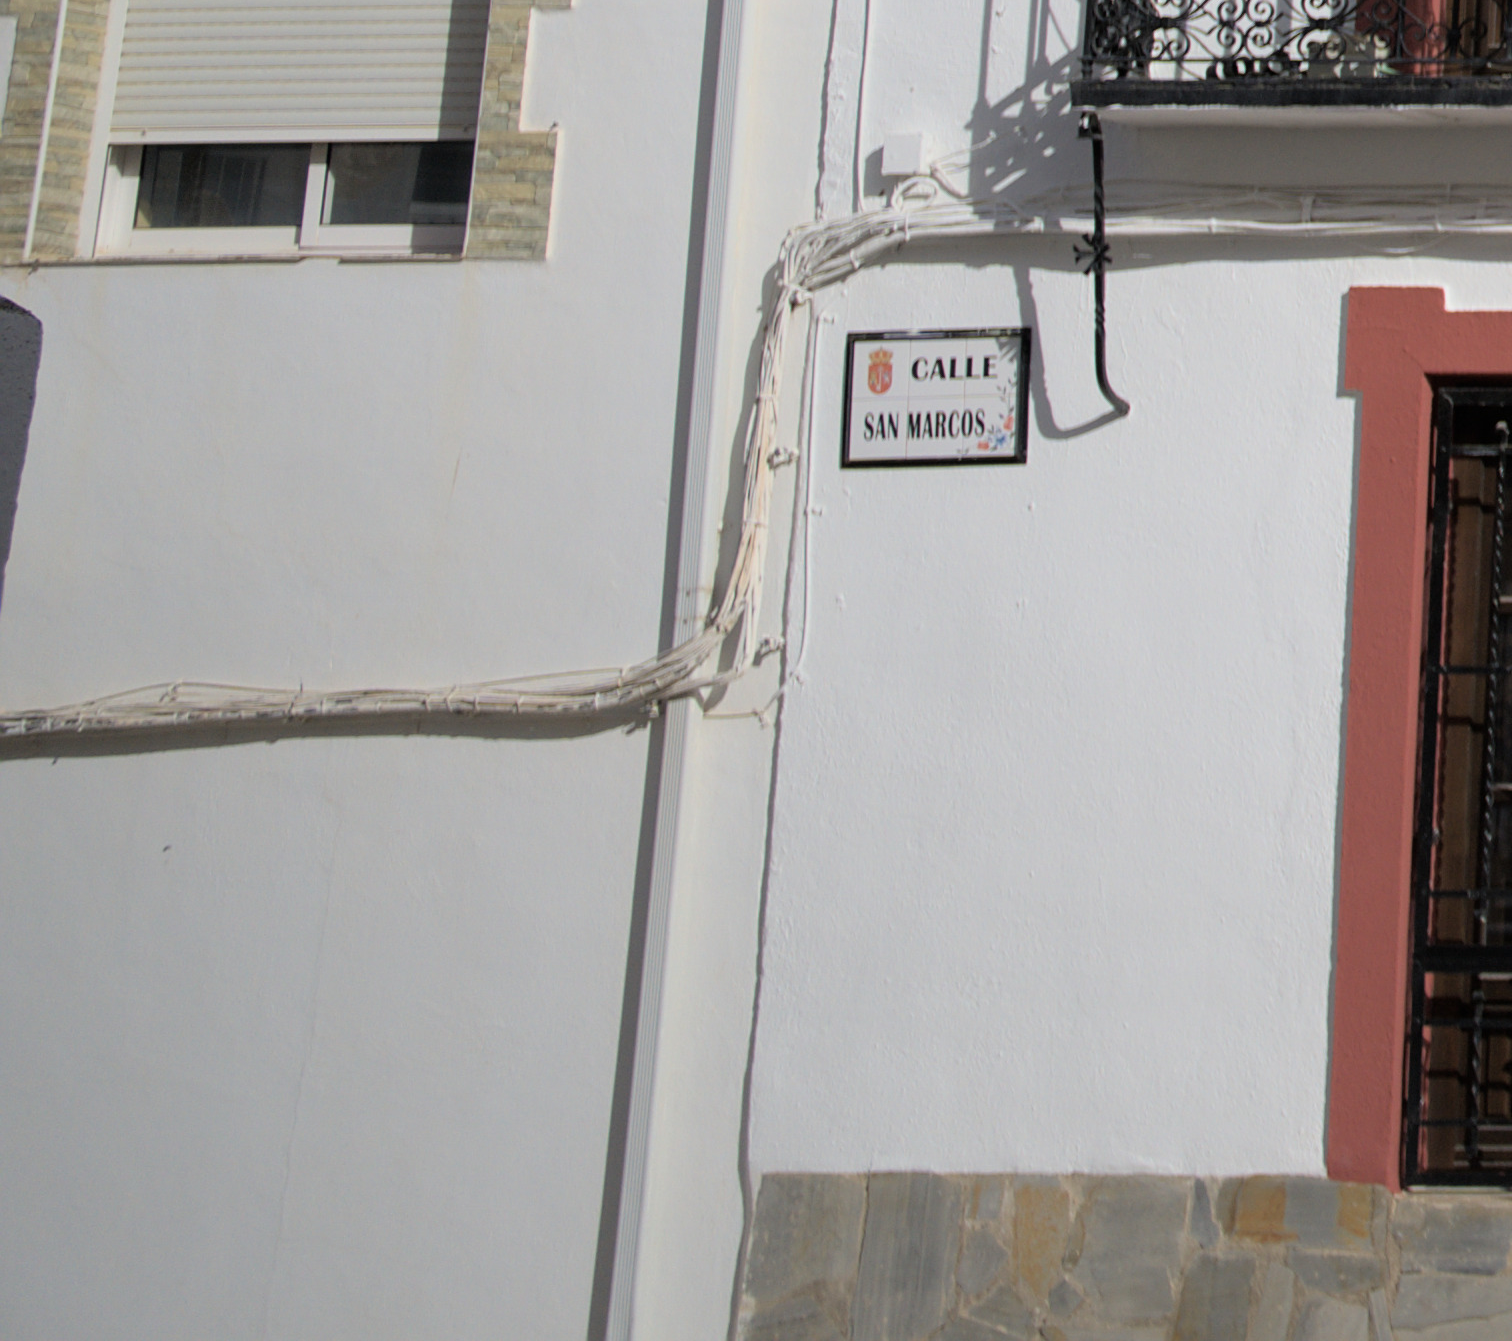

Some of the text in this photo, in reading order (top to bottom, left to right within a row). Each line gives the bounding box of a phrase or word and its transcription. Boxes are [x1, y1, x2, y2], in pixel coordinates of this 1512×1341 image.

[911, 355, 998, 381] CALLE
[863, 408, 987, 442] SAN MARCOS
